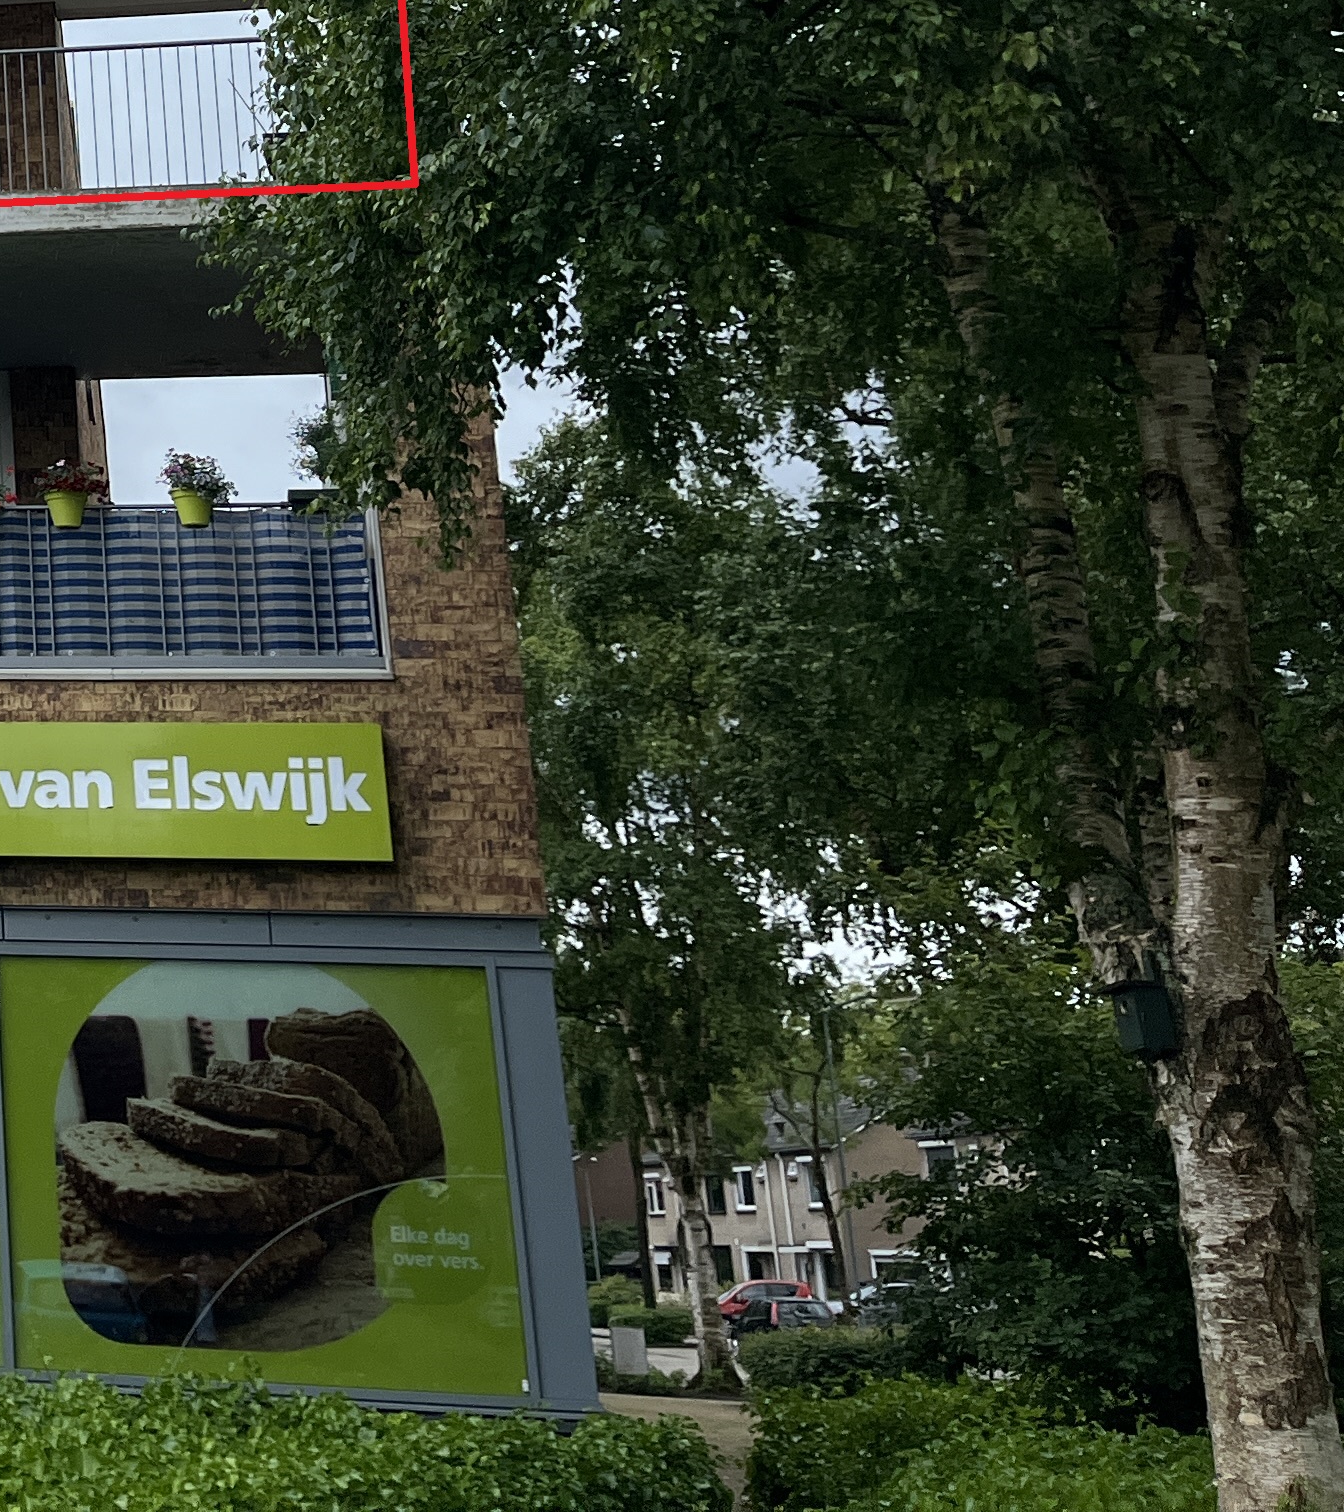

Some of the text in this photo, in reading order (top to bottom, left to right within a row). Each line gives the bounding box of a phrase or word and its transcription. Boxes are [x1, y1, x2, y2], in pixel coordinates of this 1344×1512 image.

[132, 755, 372, 826] Elswijk
[390, 1226, 470, 1251] Elke dag
[393, 1253, 485, 1270] over vers.
